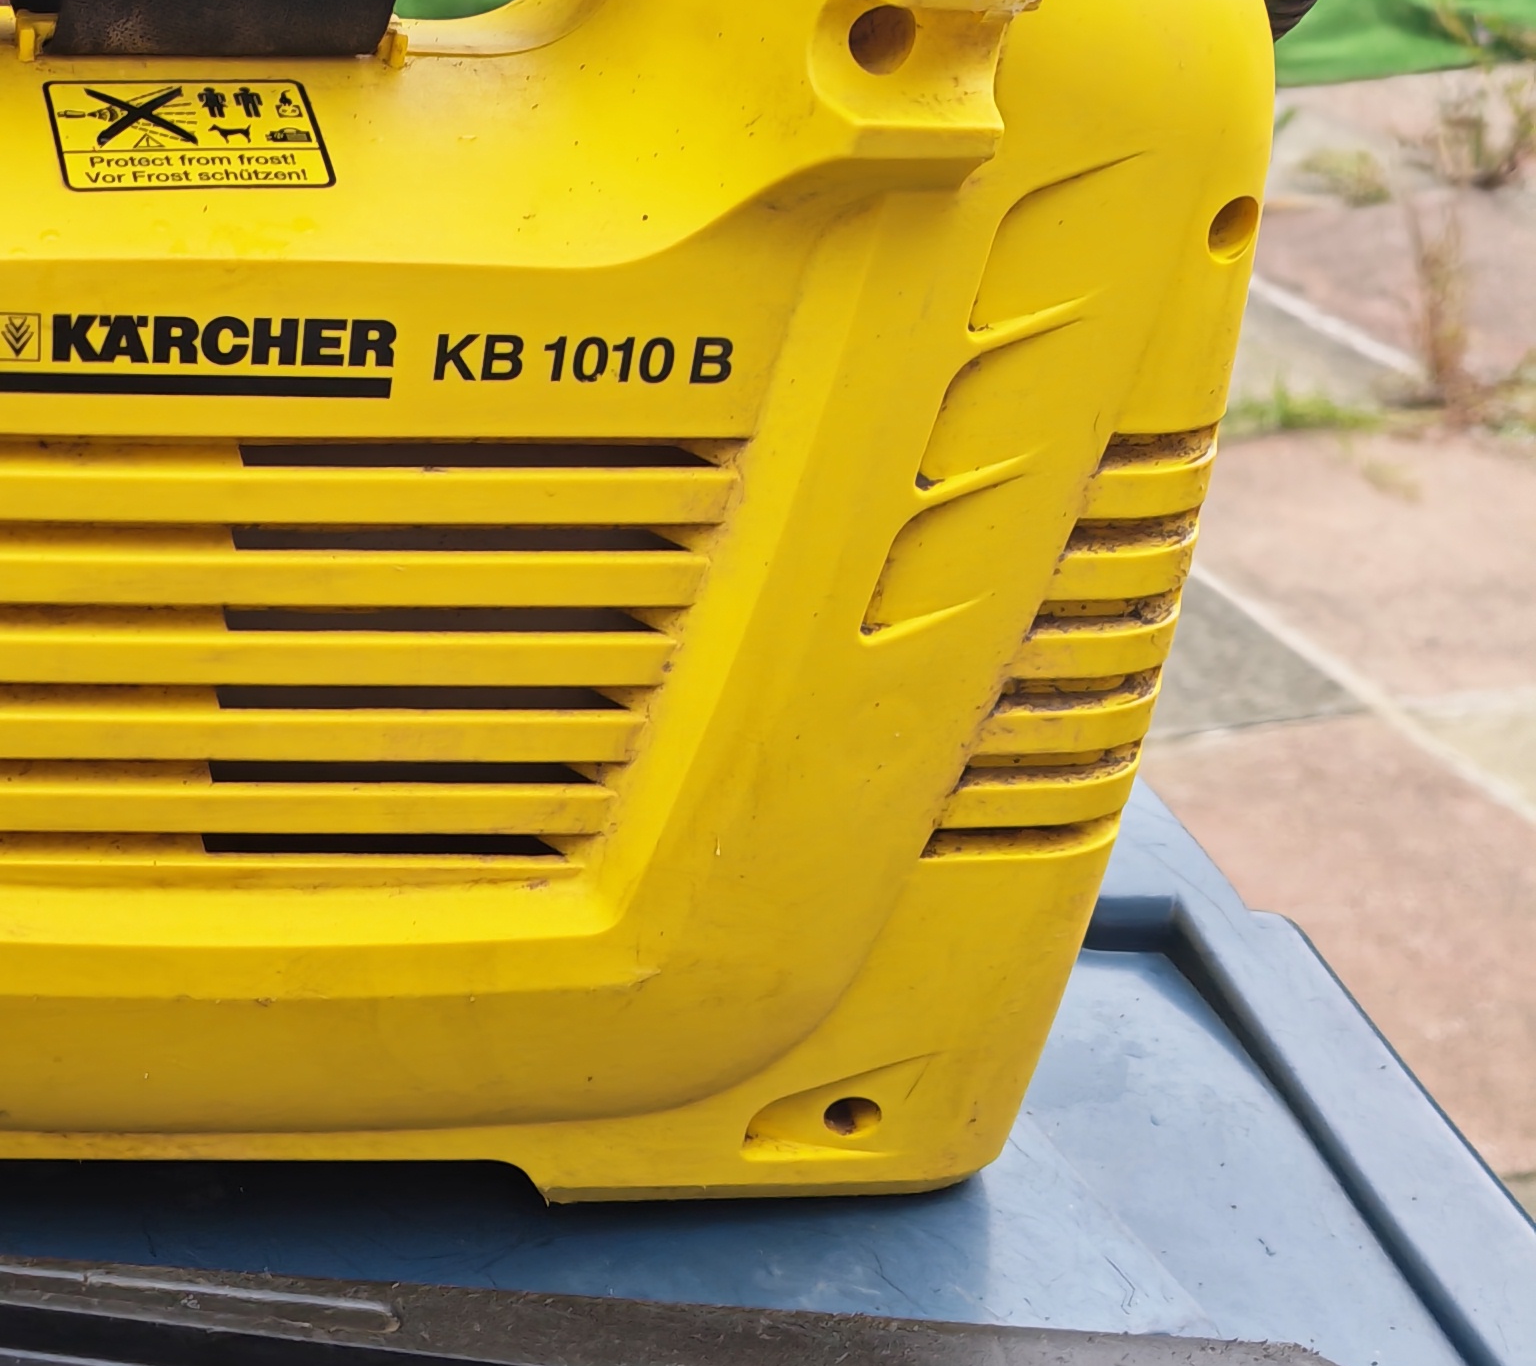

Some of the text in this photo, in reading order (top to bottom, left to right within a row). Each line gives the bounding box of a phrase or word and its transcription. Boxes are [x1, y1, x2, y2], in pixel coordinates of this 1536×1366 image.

[89, 153, 297, 168] Protect from frost!
[85, 168, 308, 185] Vor Frost schützen!
[51, 313, 734, 386] KÄRCHER KB 1010 B
